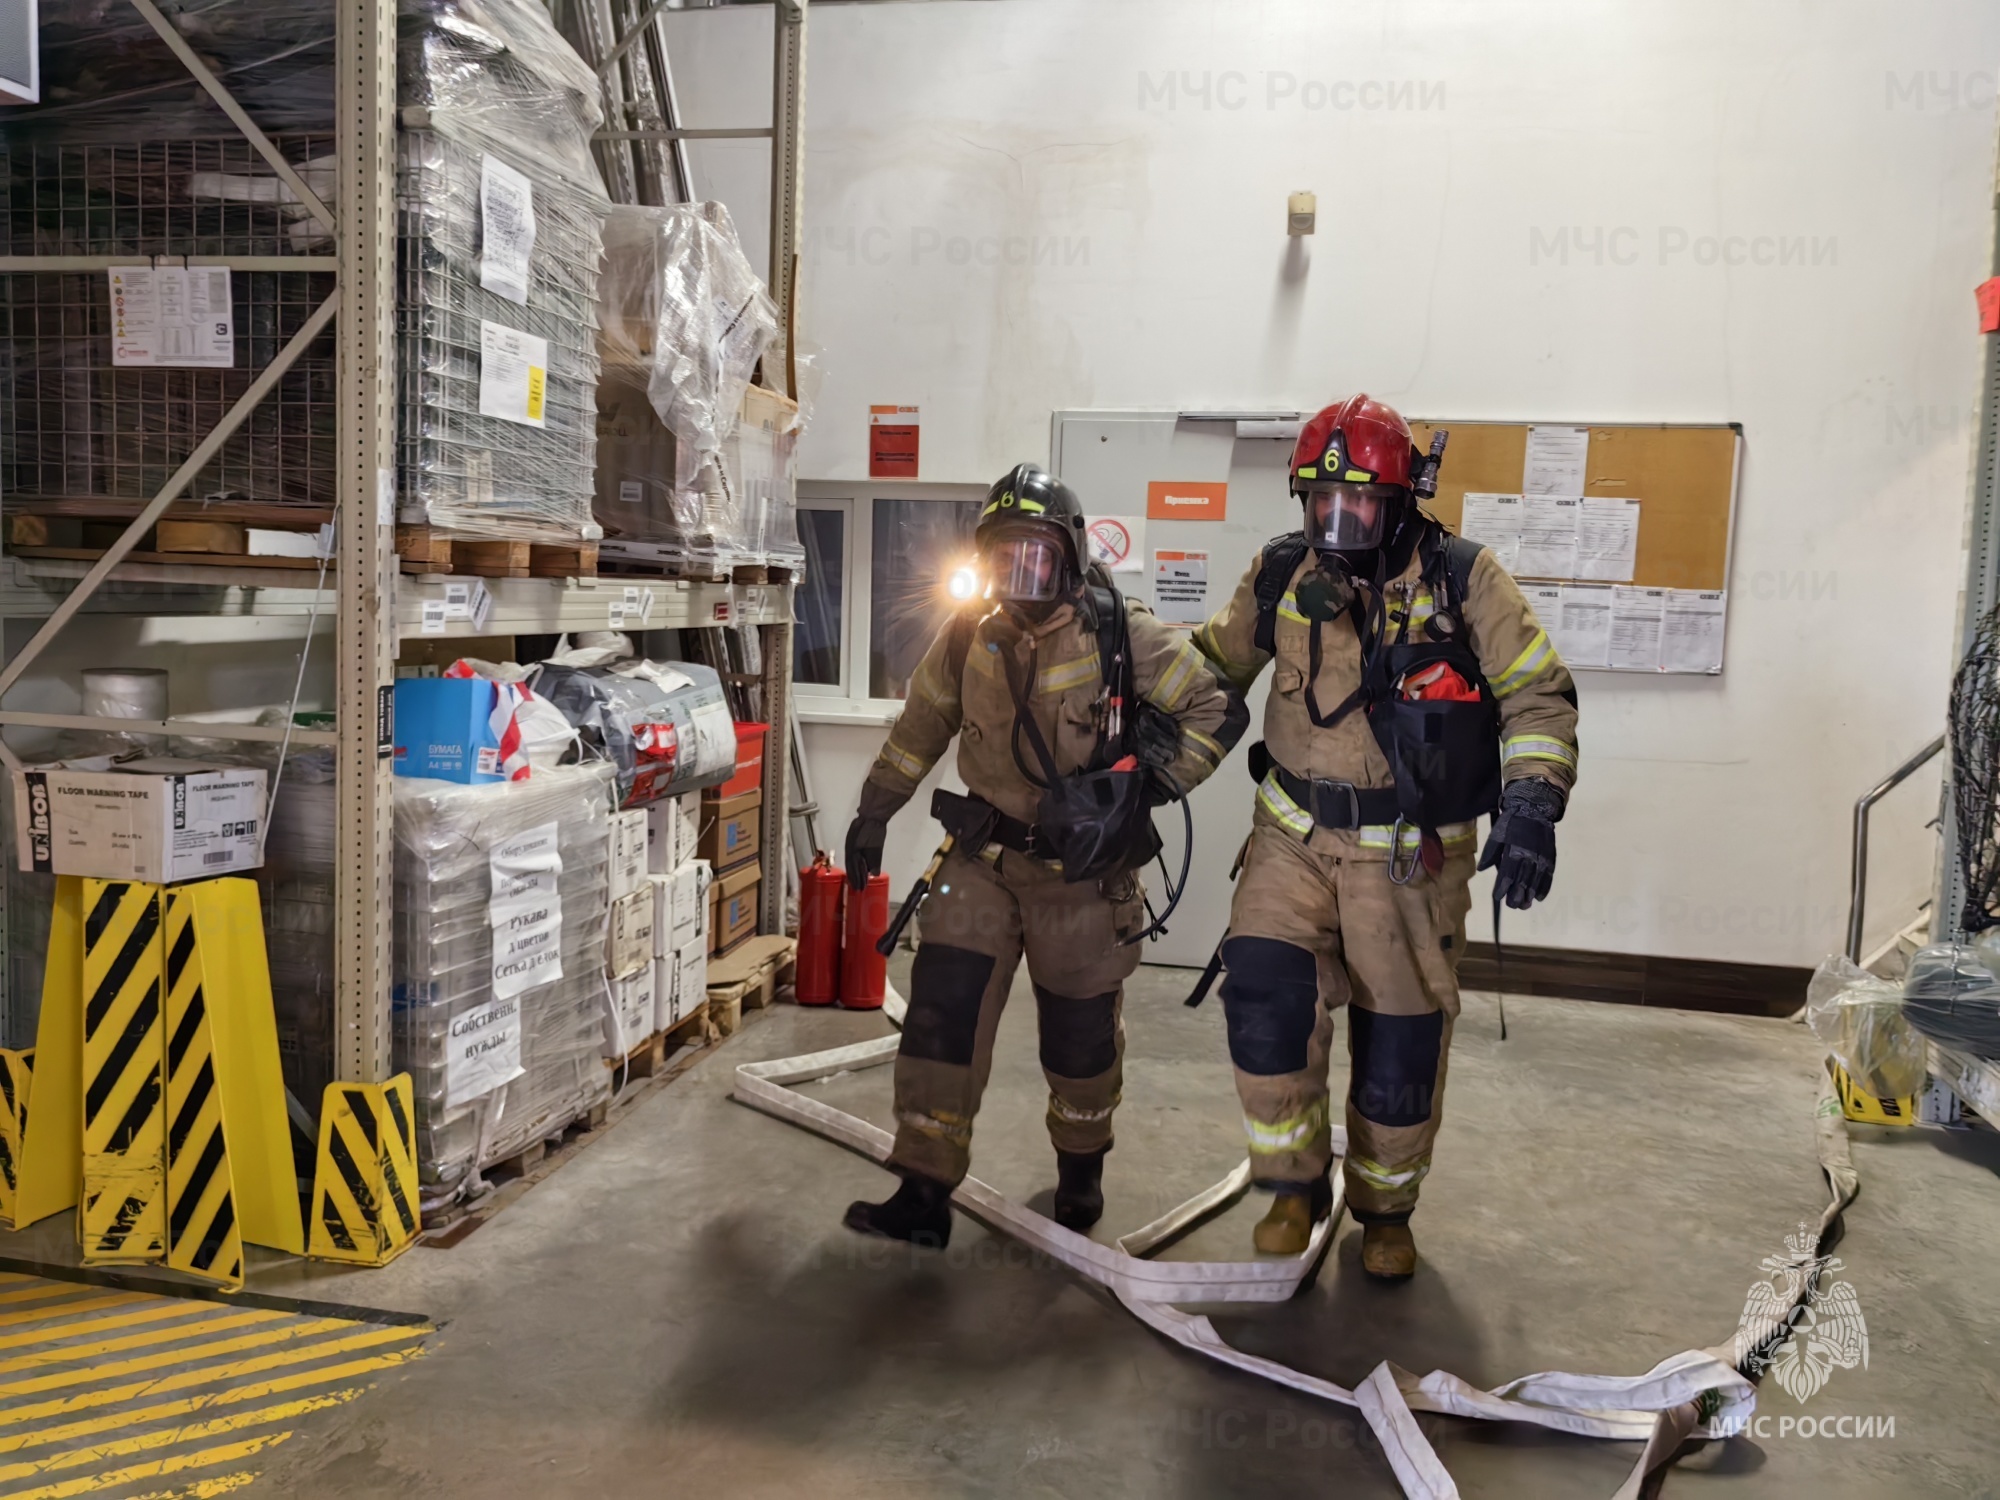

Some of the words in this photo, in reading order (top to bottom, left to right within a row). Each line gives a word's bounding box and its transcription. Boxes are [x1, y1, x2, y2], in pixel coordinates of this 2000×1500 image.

[1324, 448, 1340, 472] 6
[1000, 490, 1015, 508] 6
[428, 744, 463, 755] БУМАГА
[57, 786, 85, 796] FLOOR
[86, 787, 126, 798] WARNING
[127, 790, 149, 800] TAPE
[494, 959, 527, 980] Сетка
[452, 1002, 517, 1038] Собственн.
[465, 1031, 506, 1061] нужды
